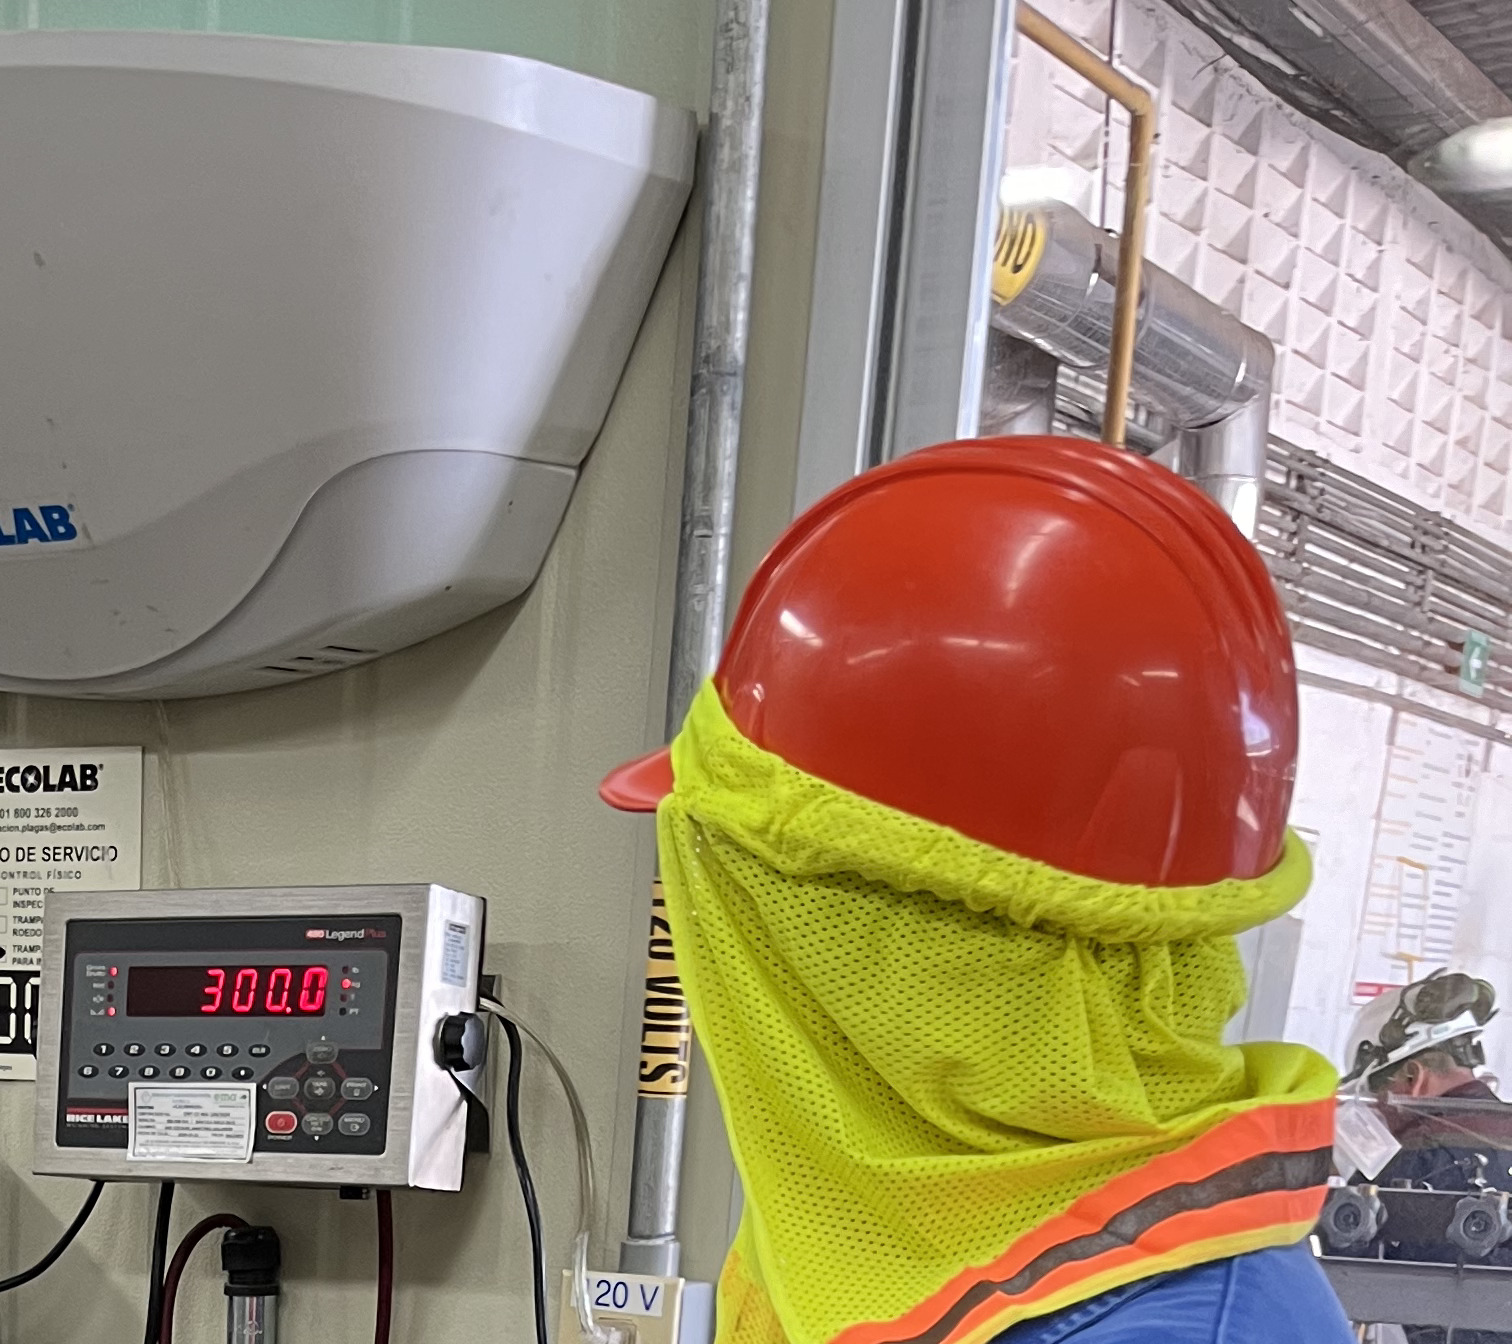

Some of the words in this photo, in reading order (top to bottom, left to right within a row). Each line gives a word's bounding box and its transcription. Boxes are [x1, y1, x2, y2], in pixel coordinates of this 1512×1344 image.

[0, 808, 11, 819] 01
[13, 808, 32, 819] 800
[34, 807, 52, 818] 326
[15, 846, 37, 862] DE
[41, 845, 118, 862] SERVICIO
[12, 887, 42, 896] PUNTO
[12, 915, 44, 924] TRAMP
[325, 928, 365, 942] Legend
[11, 957, 34, 965] PARA
[200, 967, 329, 1014] 300.0
[638, 975, 691, 1084] VOLTS
[66, 1113, 95, 1123] RICE
[639, 1283, 660, 1312] V
